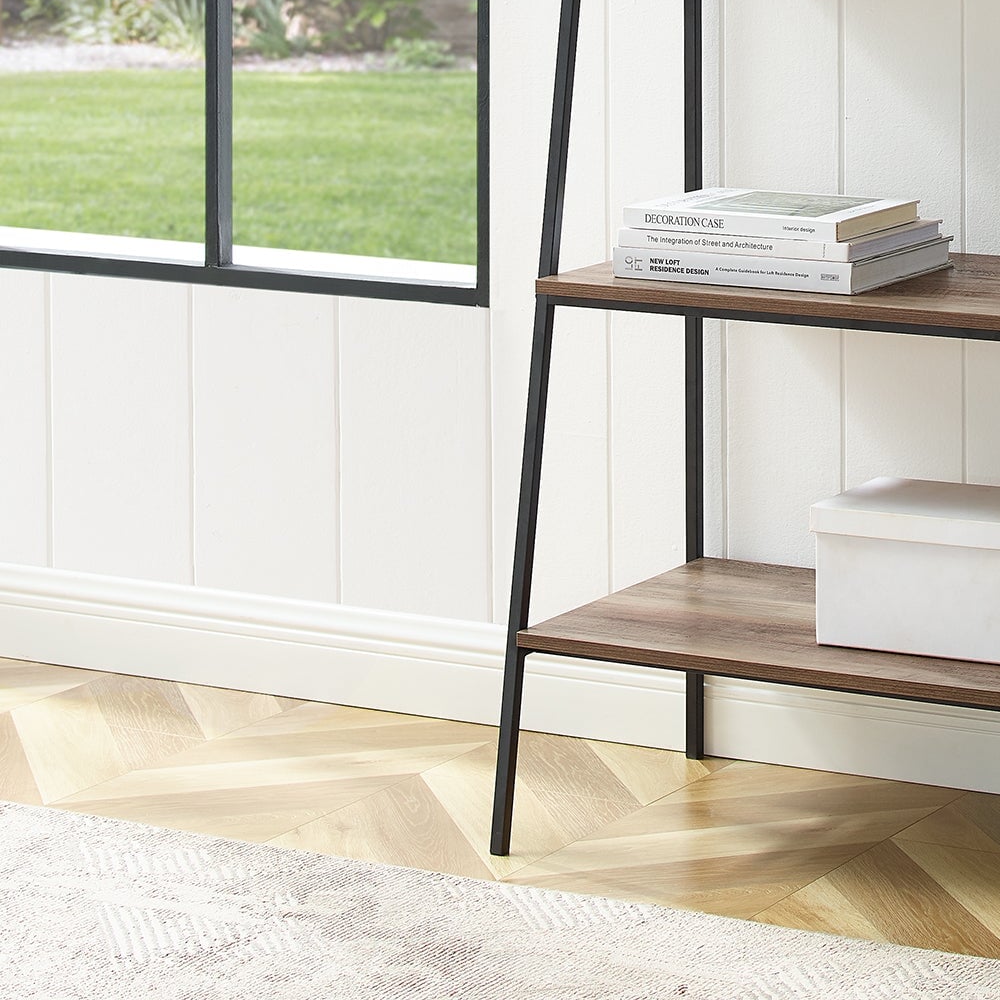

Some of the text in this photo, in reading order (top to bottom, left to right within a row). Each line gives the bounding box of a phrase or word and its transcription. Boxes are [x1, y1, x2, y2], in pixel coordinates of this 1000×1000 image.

[644, 214, 724, 229] DECORATION CASE
[660, 236, 693, 246] Integration
[702, 239, 720, 247] Street
[734, 242, 774, 250] Architecture
